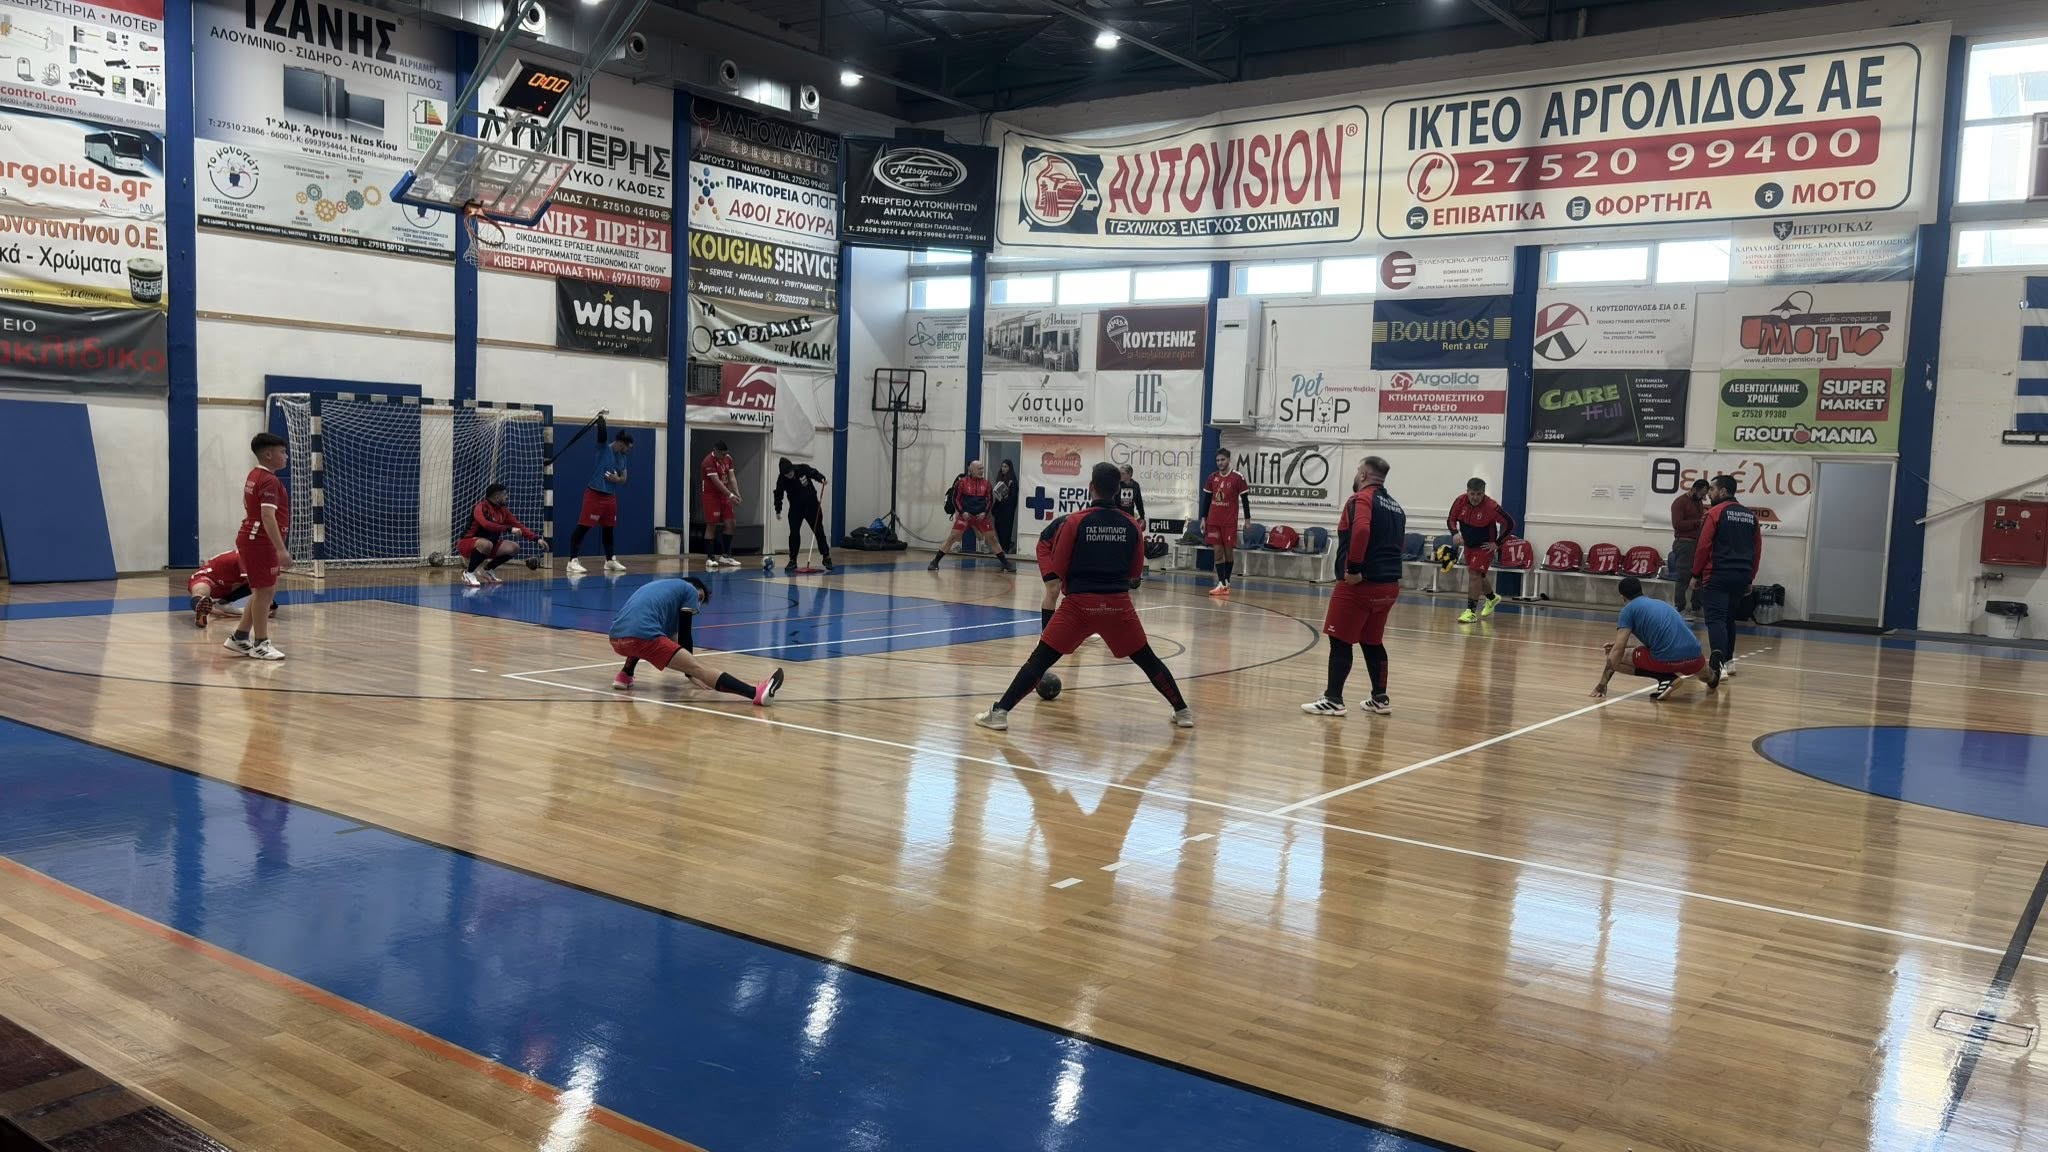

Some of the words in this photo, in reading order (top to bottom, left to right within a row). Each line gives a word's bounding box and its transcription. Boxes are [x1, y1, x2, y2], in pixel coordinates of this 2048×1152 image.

[110, 13, 157, 33] ΜΟΤΕΡ
[210, 26, 286, 54] ΑΛΟΥΜΙΝΙΟ
[296, 46, 342, 67] ΣΙΔΗΡΟ
[351, 58, 443, 91] ΑΥΤΟΜΑΤΙΣΜΟΣ
[1408, 96, 1522, 151] ΙΚΤΕΟ
[1540, 64, 1806, 139] ΑΡΓΟΛΙΔΟΣ
[1816, 55, 1886, 113] ΑΕ
[217, 120, 241, 131] 27510
[722, 110, 839, 163] ΛΑΓΟΥΔΑΚΗΣ
[1471, 146, 1638, 187] 27520
[1668, 126, 1863, 172] 99400
[889, 163, 953, 178] Mitsopoulos
[1108, 124, 1344, 216] AUTOVISION
[617, 178, 666, 198] ΚΑΦΕΣ
[726, 175, 799, 203] ΠΡΑΚΤΟΡΕΙΑ
[602, 200, 630, 214] 27510
[860, 195, 911, 207] ΣΥΝΕΡΓΕΙΟ
[913, 200, 978, 212] ΑΥΤΟΚΙΝΗΤΩΝ
[1432, 201, 1546, 227] ΕΠΙΒΑΤΙΚΑ
[1595, 190, 1713, 217] ΦΟΡΤΗΓΑ
[1790, 178, 1878, 205] ΜΟΤΟ
[728, 199, 772, 223] ΑΦΟΙ
[775, 208, 835, 236] ΣΚΟΥΡΑ
[883, 208, 953, 220] ΑΝΤΑΛΛΑΚΤΙΚΑ
[1109, 219, 1178, 235] ΤΕΧΝΙΚΟΣ
[1180, 217, 1243, 235] ΕΛΕΓΧΟΣ
[1246, 209, 1334, 231] ΟΧΗΜΑΤΩΝ
[125, 224, 163, 250] Ο.Ε.
[595, 219, 667, 252] ΠΡΕΪΣΙ
[1793, 221, 1873, 236] ΠΕΤΡΟΓΚΑΖ
[516, 231, 563, 248] ΟΙΚΟΔΟΜΙΚΕΣ
[564, 239, 594, 252] ΕΡΓΑΣΙΕΣ
[596, 245, 640, 260] ΑΝΑΚΑΙΝΙΣΕΙΣ
[526, 246, 582, 262] ΠΡΟΓΡΑΜΜΑΤΟΣ
[39, 245, 121, 275] Χρώματα
[688, 232, 773, 270] KOUGIAS
[774, 247, 838, 281] SERVICE
[493, 255, 528, 270] ΚΙΒΕΡΙ
[530, 260, 584, 277] ΑΡΓΟΛΙΔΑΣ
[612, 269, 661, 288] 6976118309
[709, 268, 734, 278] SERVICE
[739, 273, 780, 286] ΑΝΤΑΛΛΑΚΤΙΚΑ
[131, 276, 162, 289] HYPER
[573, 299, 653, 334] wish
[699, 301, 716, 318] ΤΑ
[714, 316, 812, 347] ΣΟΥΒΛΑΚΙΑ
[936, 330, 967, 342] electron
[1122, 330, 1197, 349] ΚΟΥΣΤΕΝΗΣ
[789, 340, 832, 361] ΚΑΔΗ
[936, 341, 962, 352] energy
[1442, 342, 1463, 350] Rent
[1473, 342, 1489, 350] car
[1291, 373, 1325, 399] Pet
[1414, 372, 1479, 387] Argolida
[1822, 379, 1886, 395] SUPER
[1729, 383, 1800, 394] ΛΕΒΕΝΤΟΓΙΑΝΝΗΣ
[1388, 393, 1485, 402] ΚΤΗΜΑΤΟΜΕΣΙΤΙΚΟ
[1539, 384, 1620, 411] CARE
[1746, 395, 1779, 404] ΧΡΟΝΗΣ
[1820, 398, 1885, 411] MARKET
[1413, 404, 1457, 412] ΓΡΑΦΕΙΟ
[1741, 410, 1763, 418] 27520
[1313, 423, 1350, 434] animal
[1111, 443, 1194, 468] Grimani
[1249, 487, 1320, 497] ΗΤΟΠΩΛΕΙΟ
[1150, 520, 1170, 532] grill
[1086, 534, 1127, 543] ΠΟΛΥΝΙΚΗΣ
[1508, 545, 1525, 562] 14
[1553, 550, 1569, 568] 23
[1598, 555, 1615, 571] 77
[1631, 559, 1649, 574] 28
